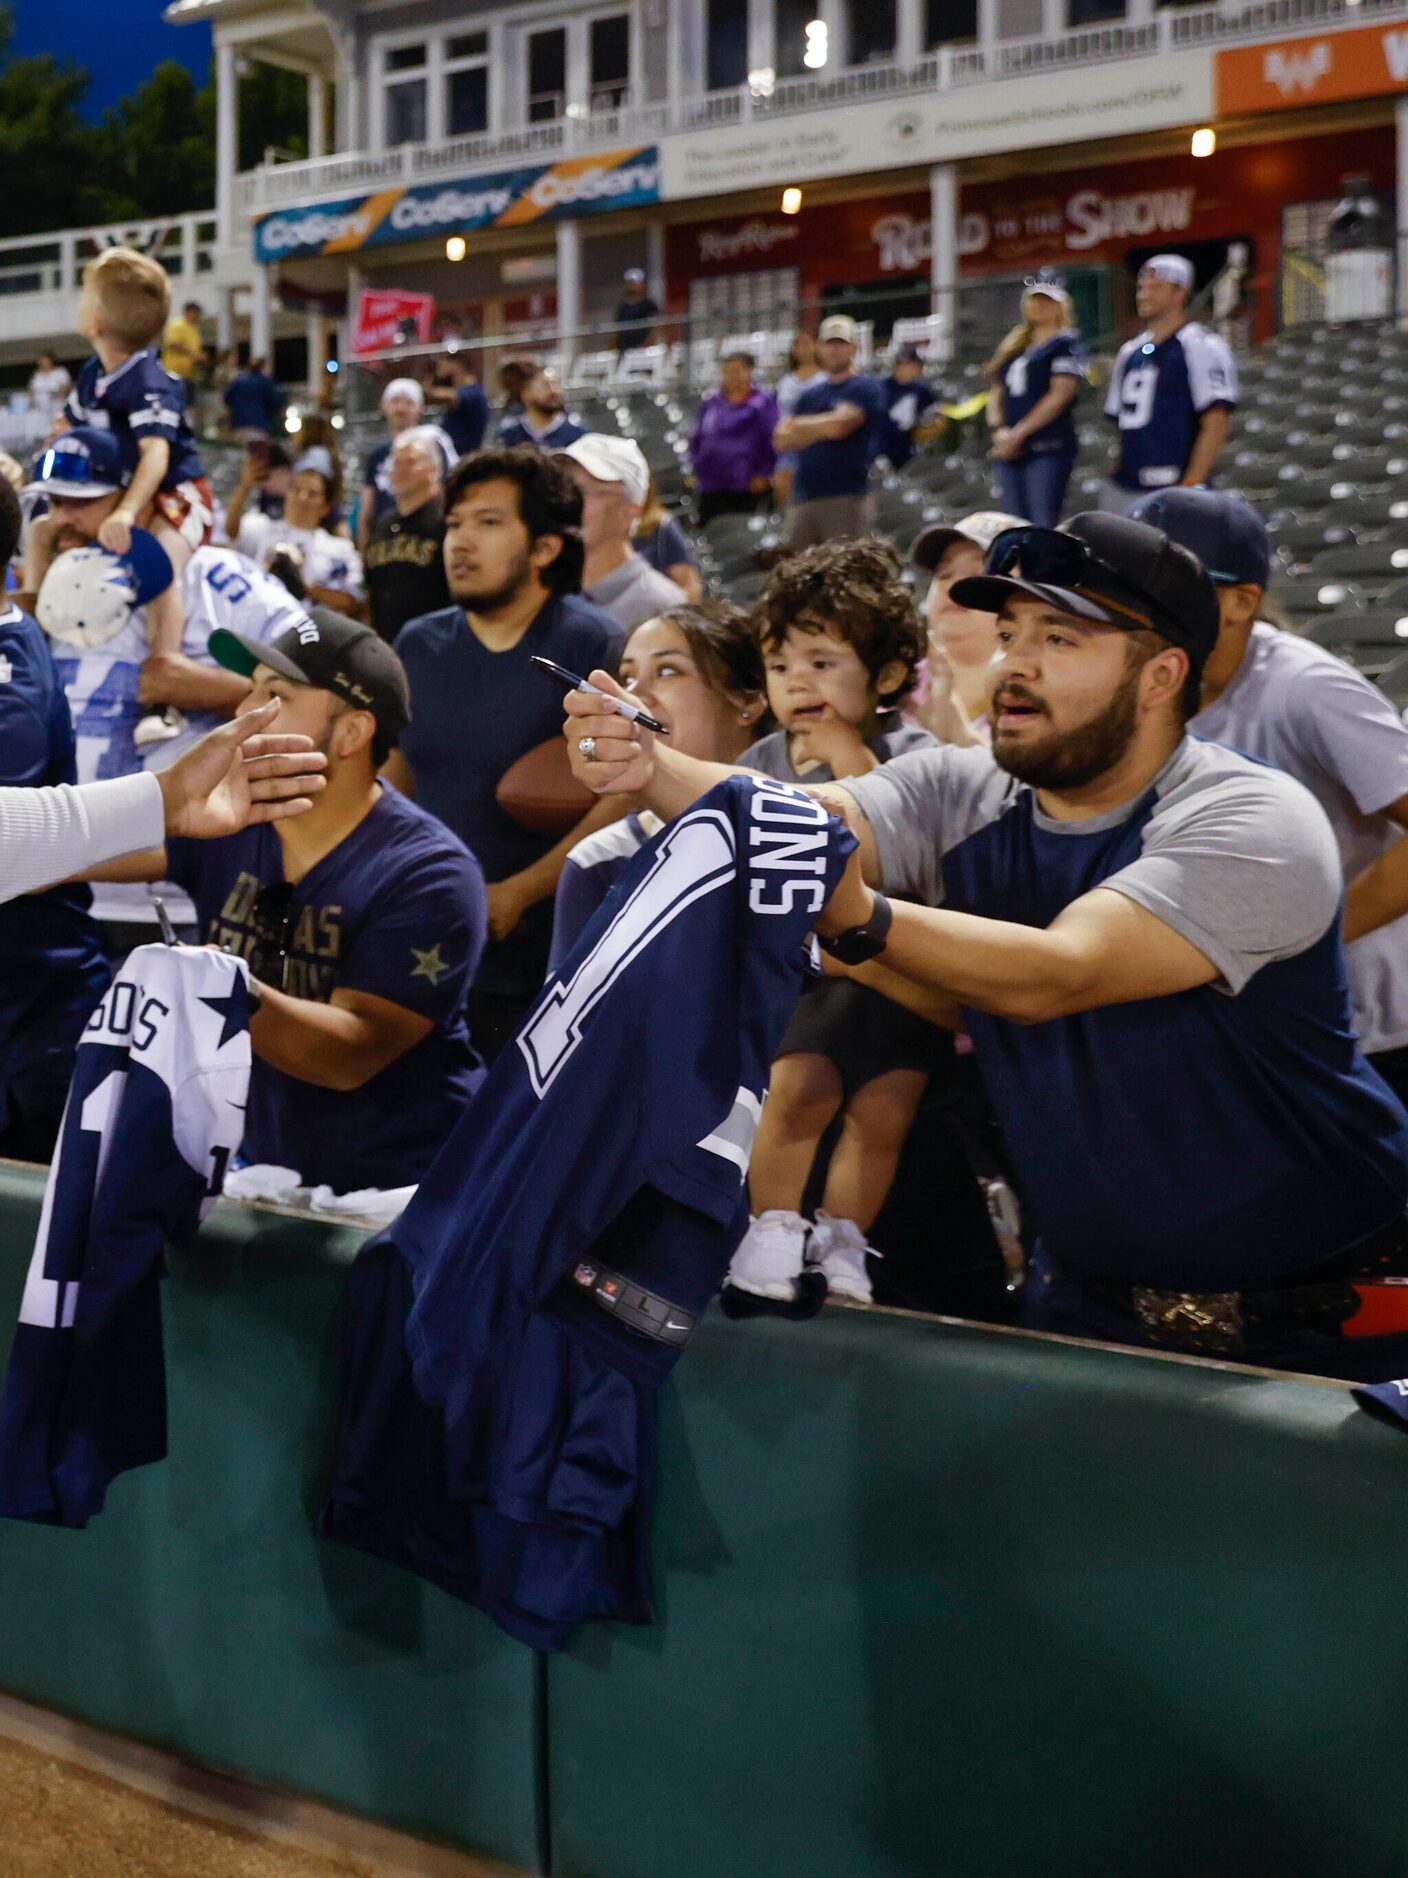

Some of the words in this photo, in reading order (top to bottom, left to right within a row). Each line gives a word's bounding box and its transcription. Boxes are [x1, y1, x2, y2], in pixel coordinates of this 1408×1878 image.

[531, 163, 658, 207] CoServ
[263, 210, 372, 250] CoServ
[392, 187, 513, 230] CoServ
[1065, 188, 1193, 251] SHOW
[1118, 362, 1160, 431] 9
